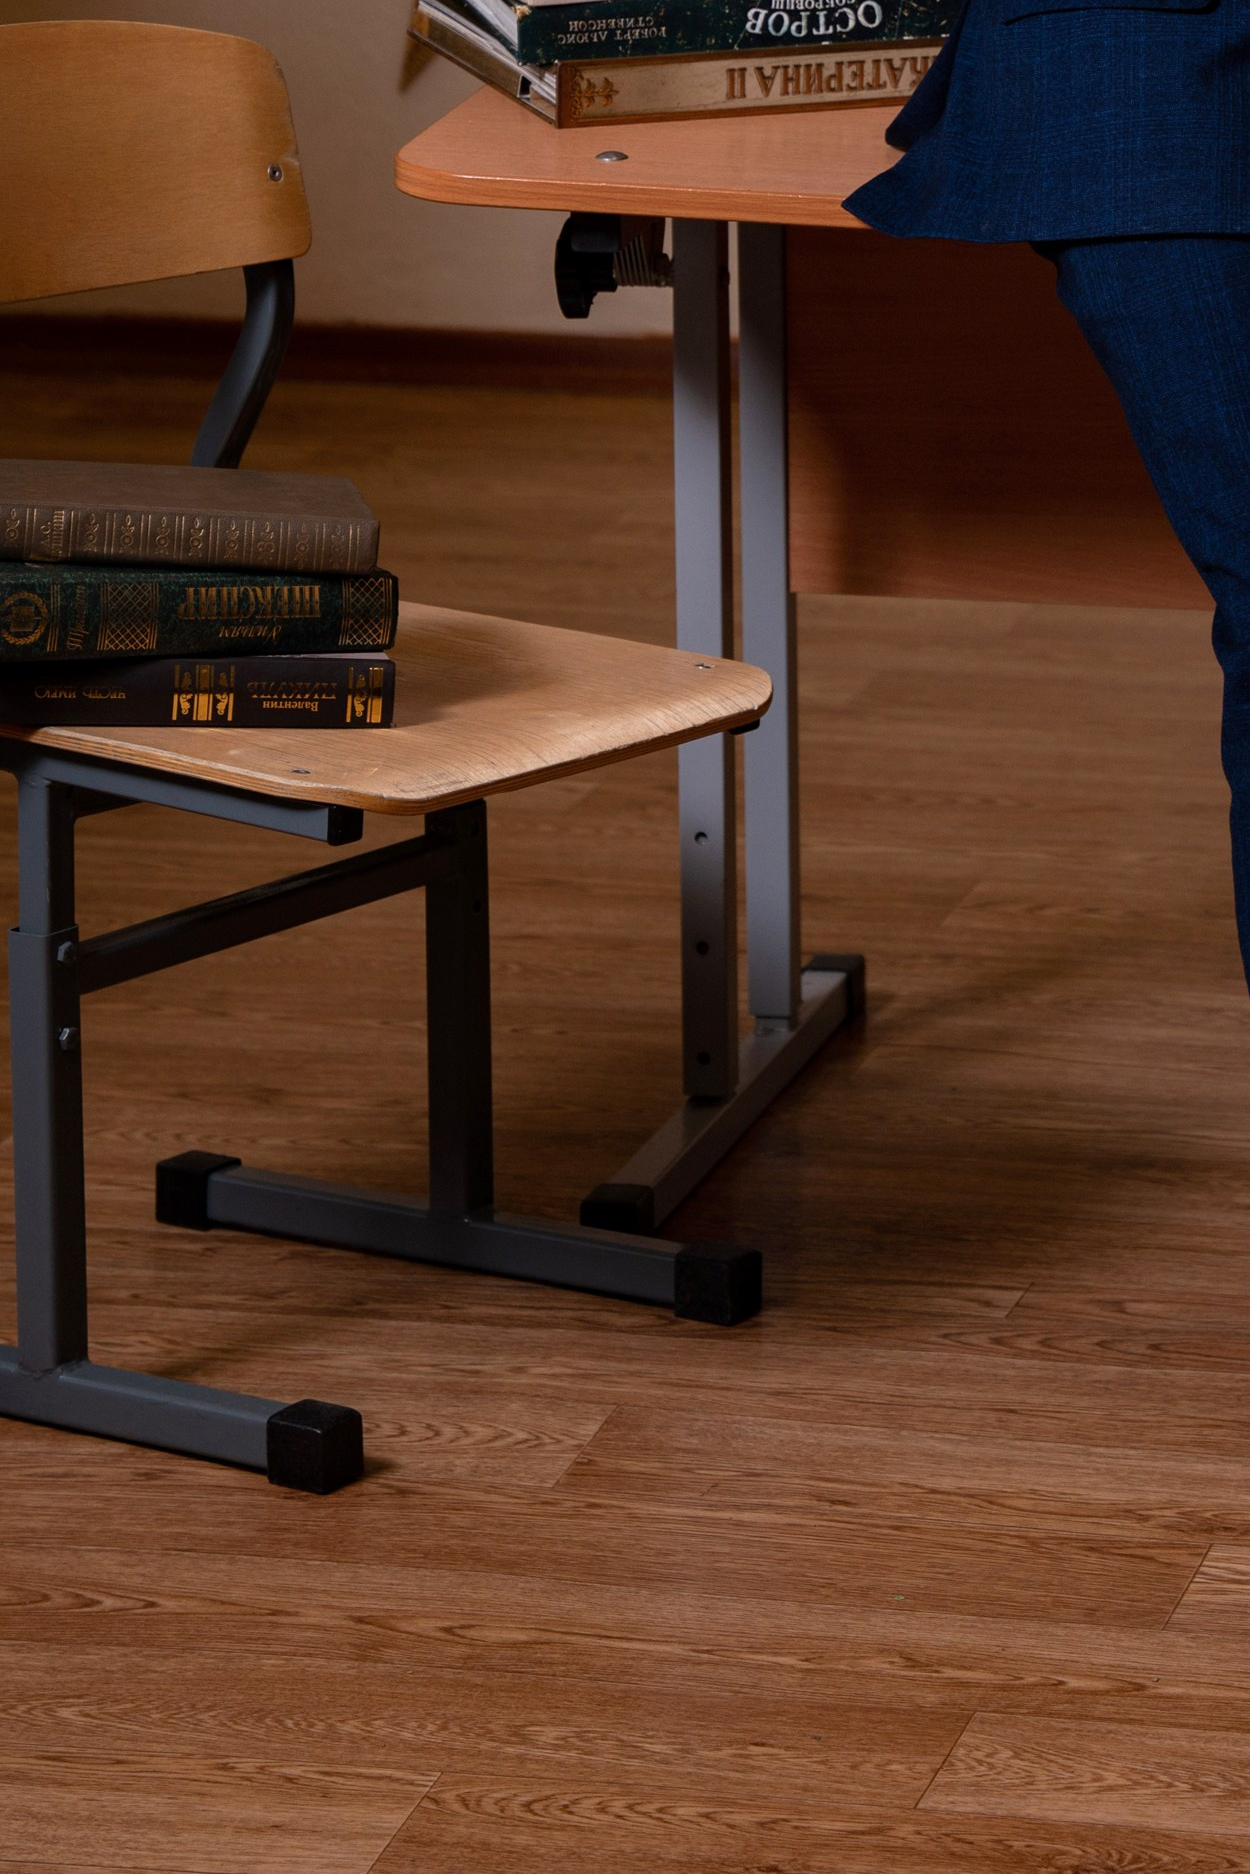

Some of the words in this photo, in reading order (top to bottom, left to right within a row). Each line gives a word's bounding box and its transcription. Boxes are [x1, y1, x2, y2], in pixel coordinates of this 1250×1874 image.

[569, 15, 654, 32] СТИВЕНСОН
[746, 0, 884, 39] ОСТРОВ
[557, 30, 608, 46] ЛЬЮИС
[614, 25, 667, 44] РОБЕРТ
[754, 54, 937, 100] КАТЕРИНА
[178, 584, 321, 622] ШЕКСПИР
[218, 622, 283, 645] Уильям
[34, 684, 77, 700] ИМЕЮ
[83, 685, 127, 700] ЧЕСТЬ
[247, 681, 338, 700] ПИКУЛЬ
[262, 699, 319, 713] Валентин
